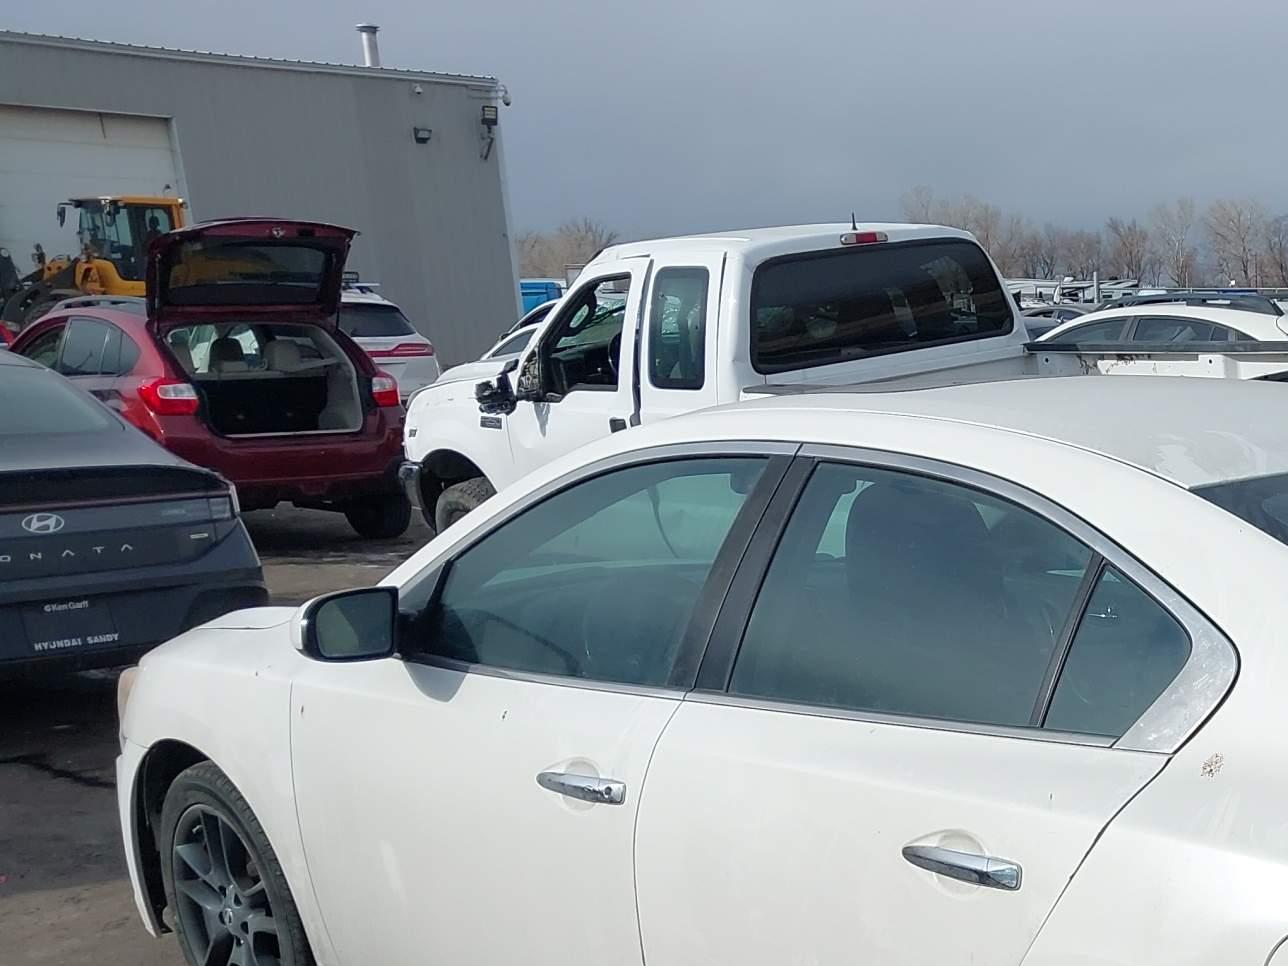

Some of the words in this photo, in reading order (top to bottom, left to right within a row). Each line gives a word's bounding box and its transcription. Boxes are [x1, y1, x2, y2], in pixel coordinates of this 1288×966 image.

[0, 543, 134, 562] ONATA
[33, 638, 83, 651] HYUNDAI
[86, 633, 119, 644] SANDY
